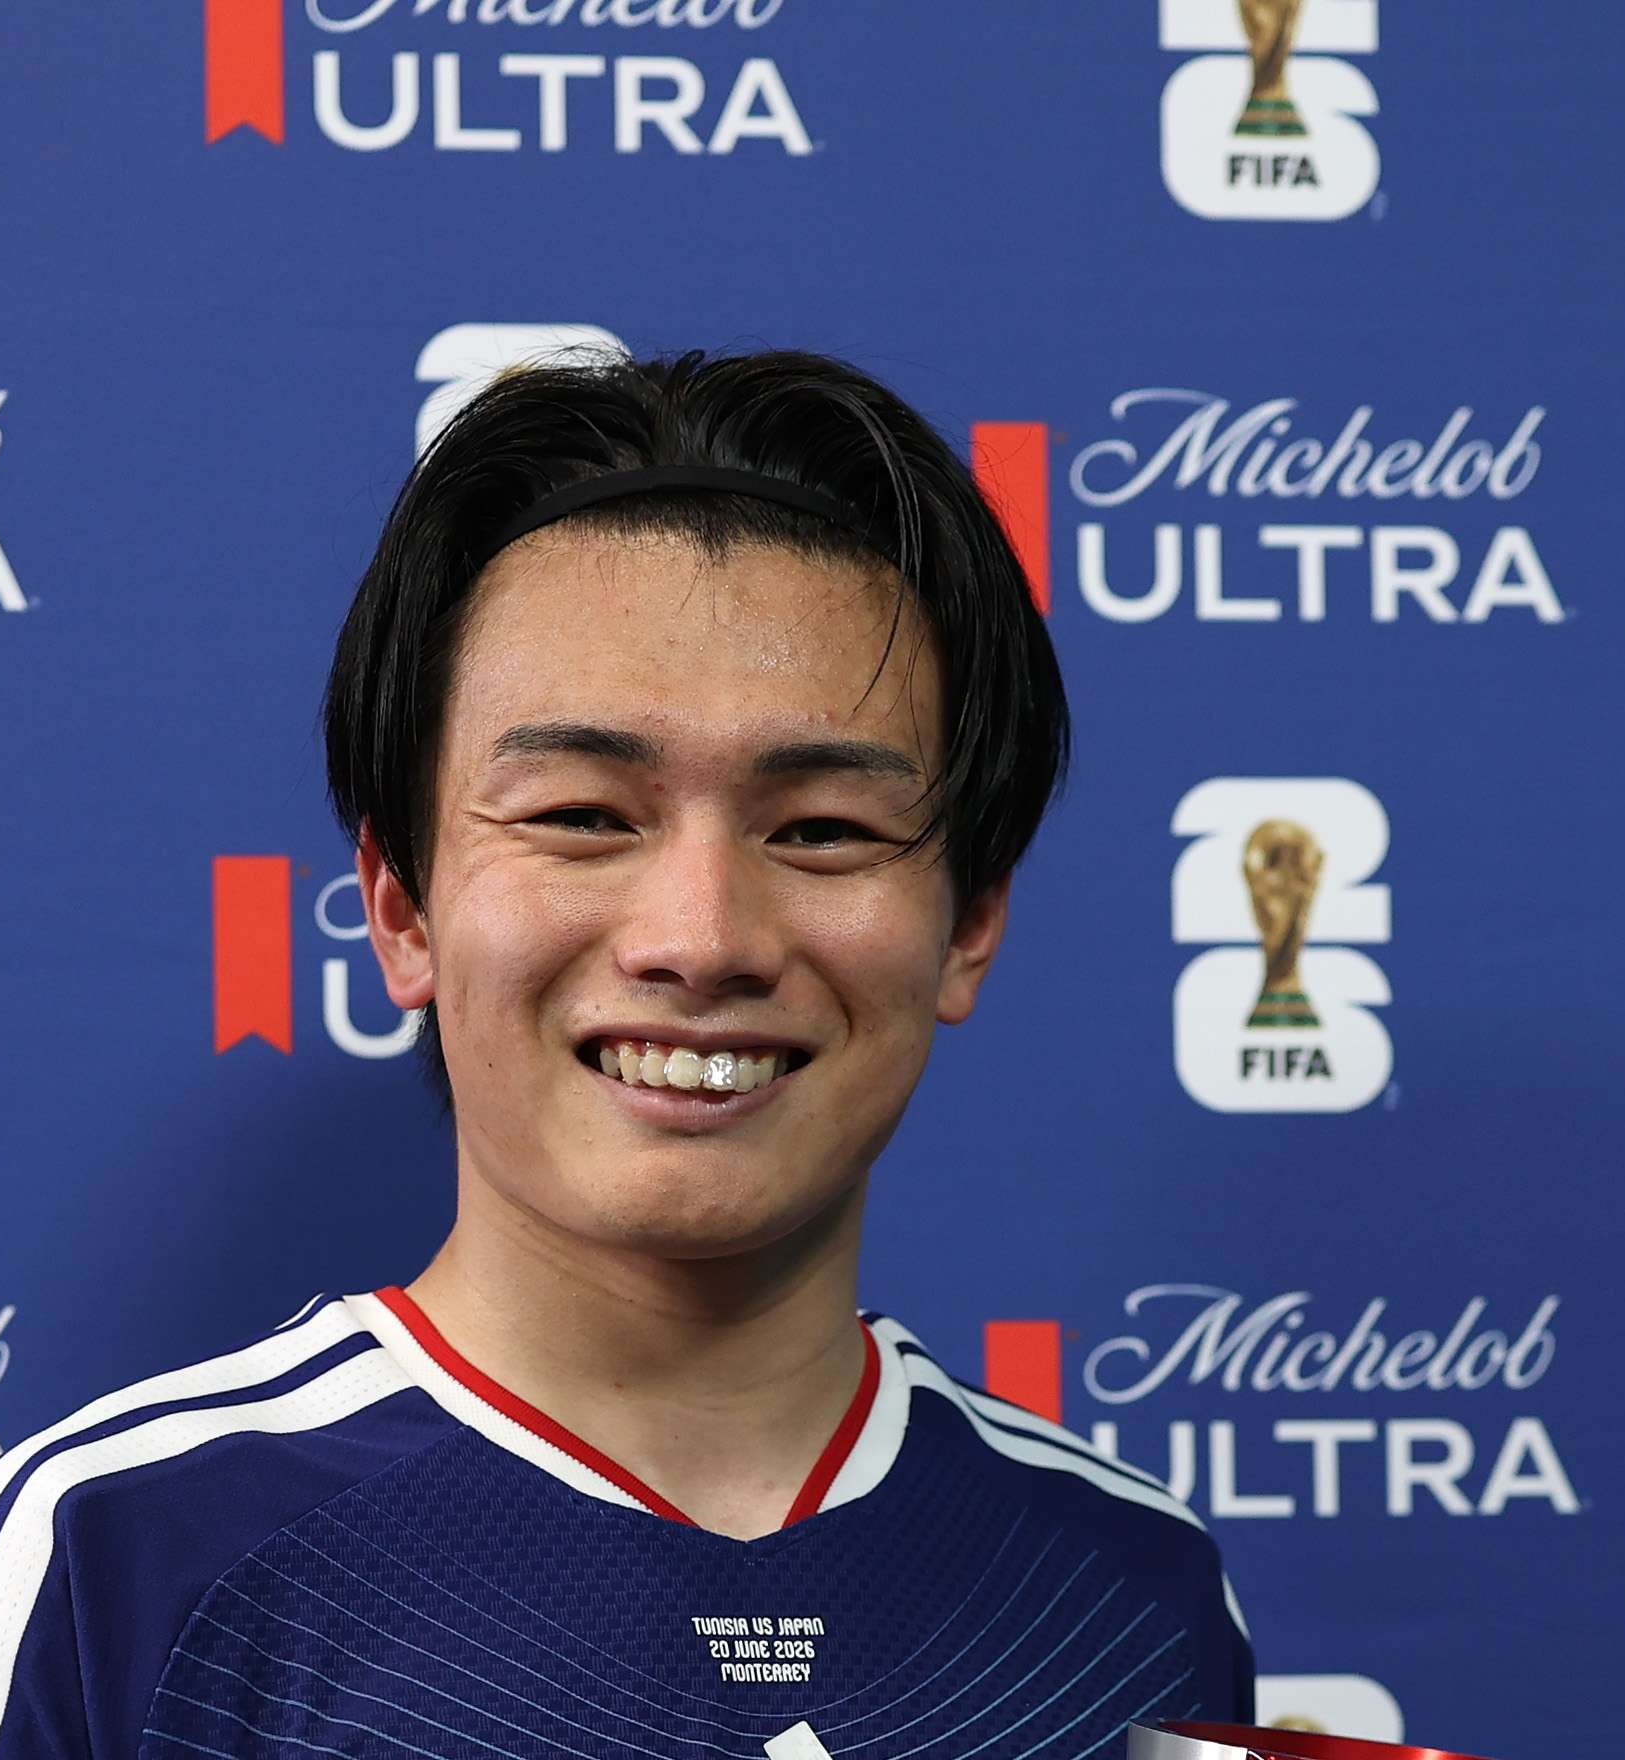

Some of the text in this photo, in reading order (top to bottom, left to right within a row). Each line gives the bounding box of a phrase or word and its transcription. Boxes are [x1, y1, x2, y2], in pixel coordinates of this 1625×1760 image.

[313, 51, 811, 155] ULTRA
[1228, 154, 1318, 187] FIFA
[1070, 389, 1545, 507] Michelob
[1077, 523, 1564, 623] ULTRA
[1240, 1047, 1332, 1079] FIFA
[1084, 1284, 1559, 1404] Michelob
[691, 1617, 825, 1636] TUNISIA VS JAPAN
[709, 1640, 815, 1659] 20 JUNE 2026
[721, 1663, 811, 1682] MONTERREY
